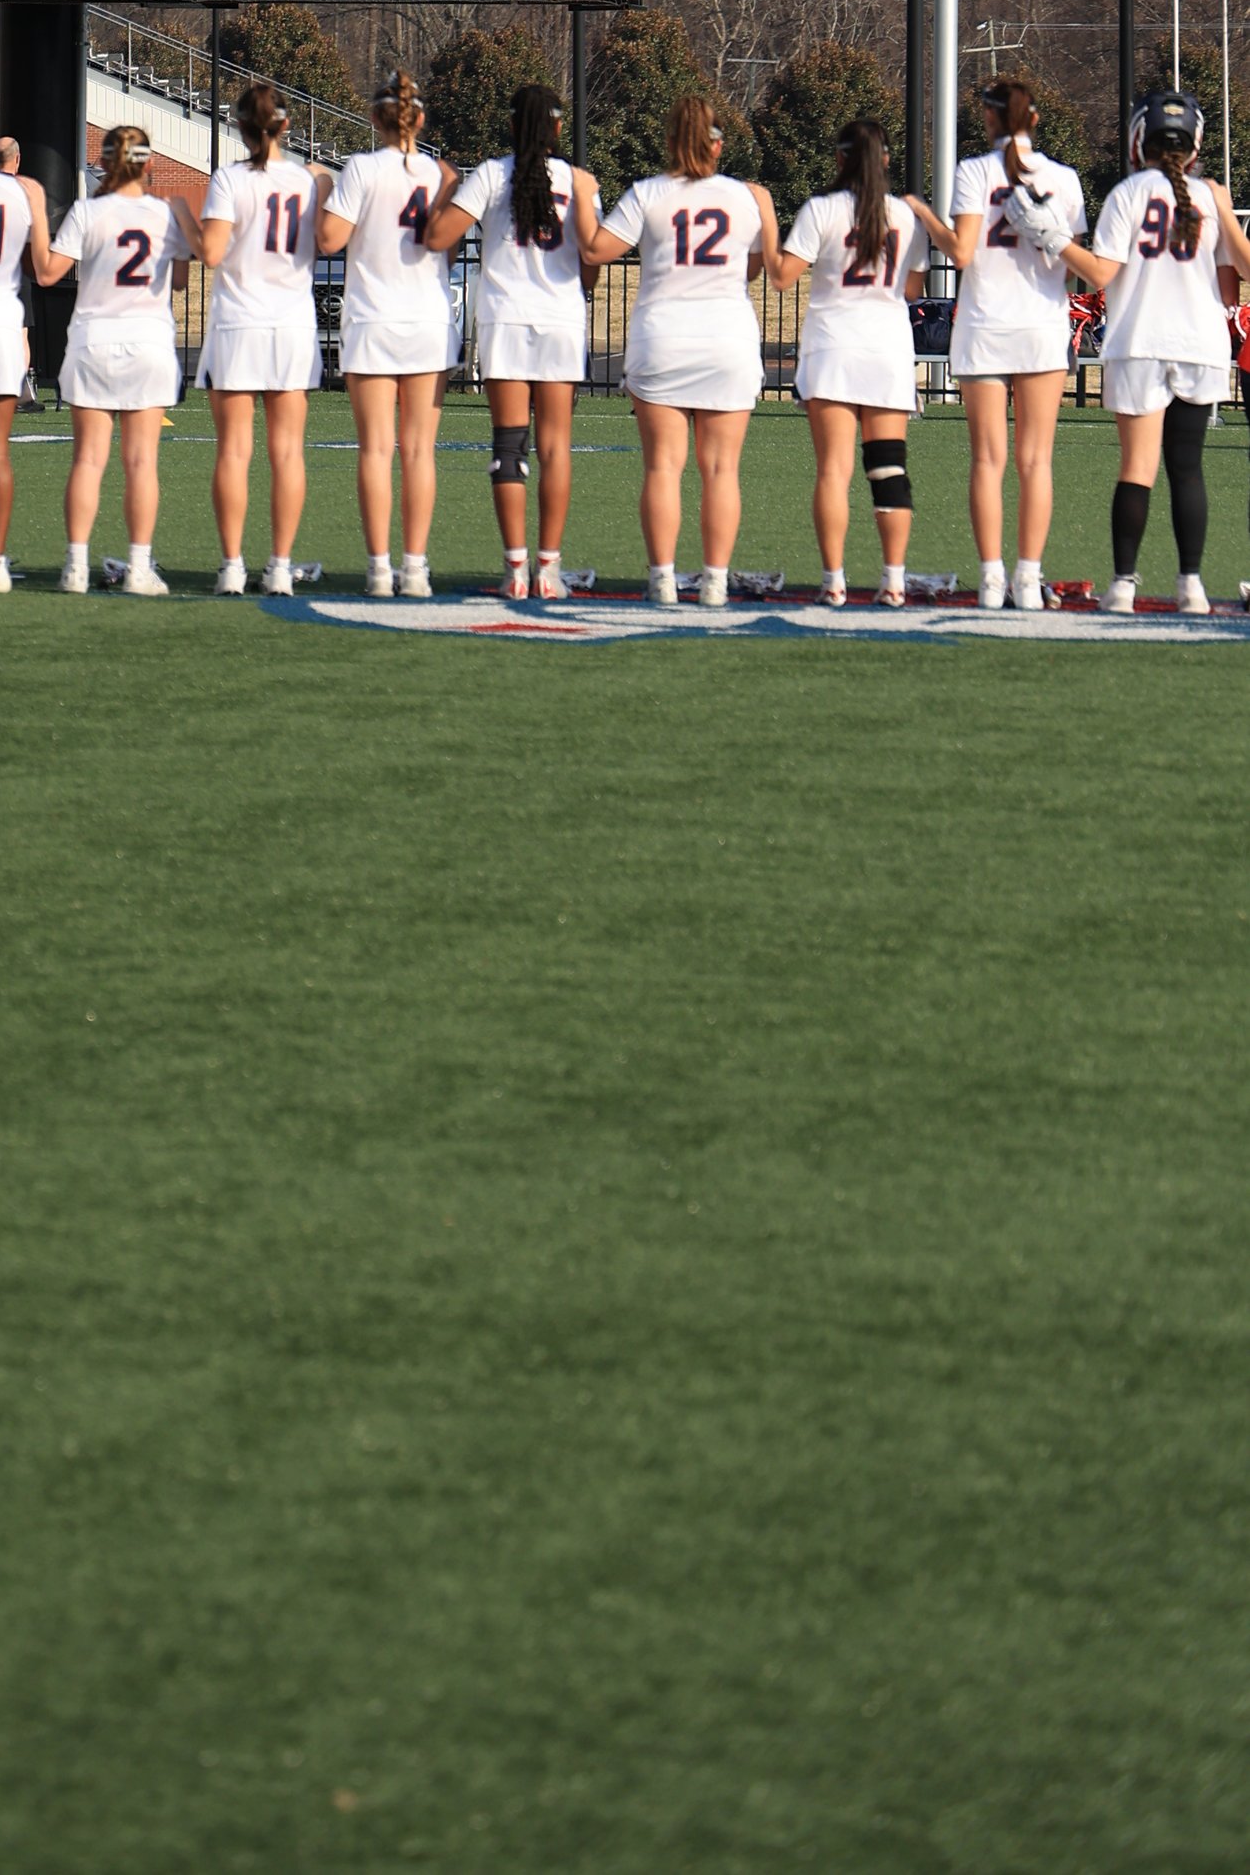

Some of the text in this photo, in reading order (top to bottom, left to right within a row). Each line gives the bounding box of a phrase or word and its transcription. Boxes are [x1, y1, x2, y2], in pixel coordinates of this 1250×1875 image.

[265, 192, 302, 254] 11
[672, 208, 730, 266] 12
[115, 229, 151, 287] 2
[842, 228, 899, 287] 21
